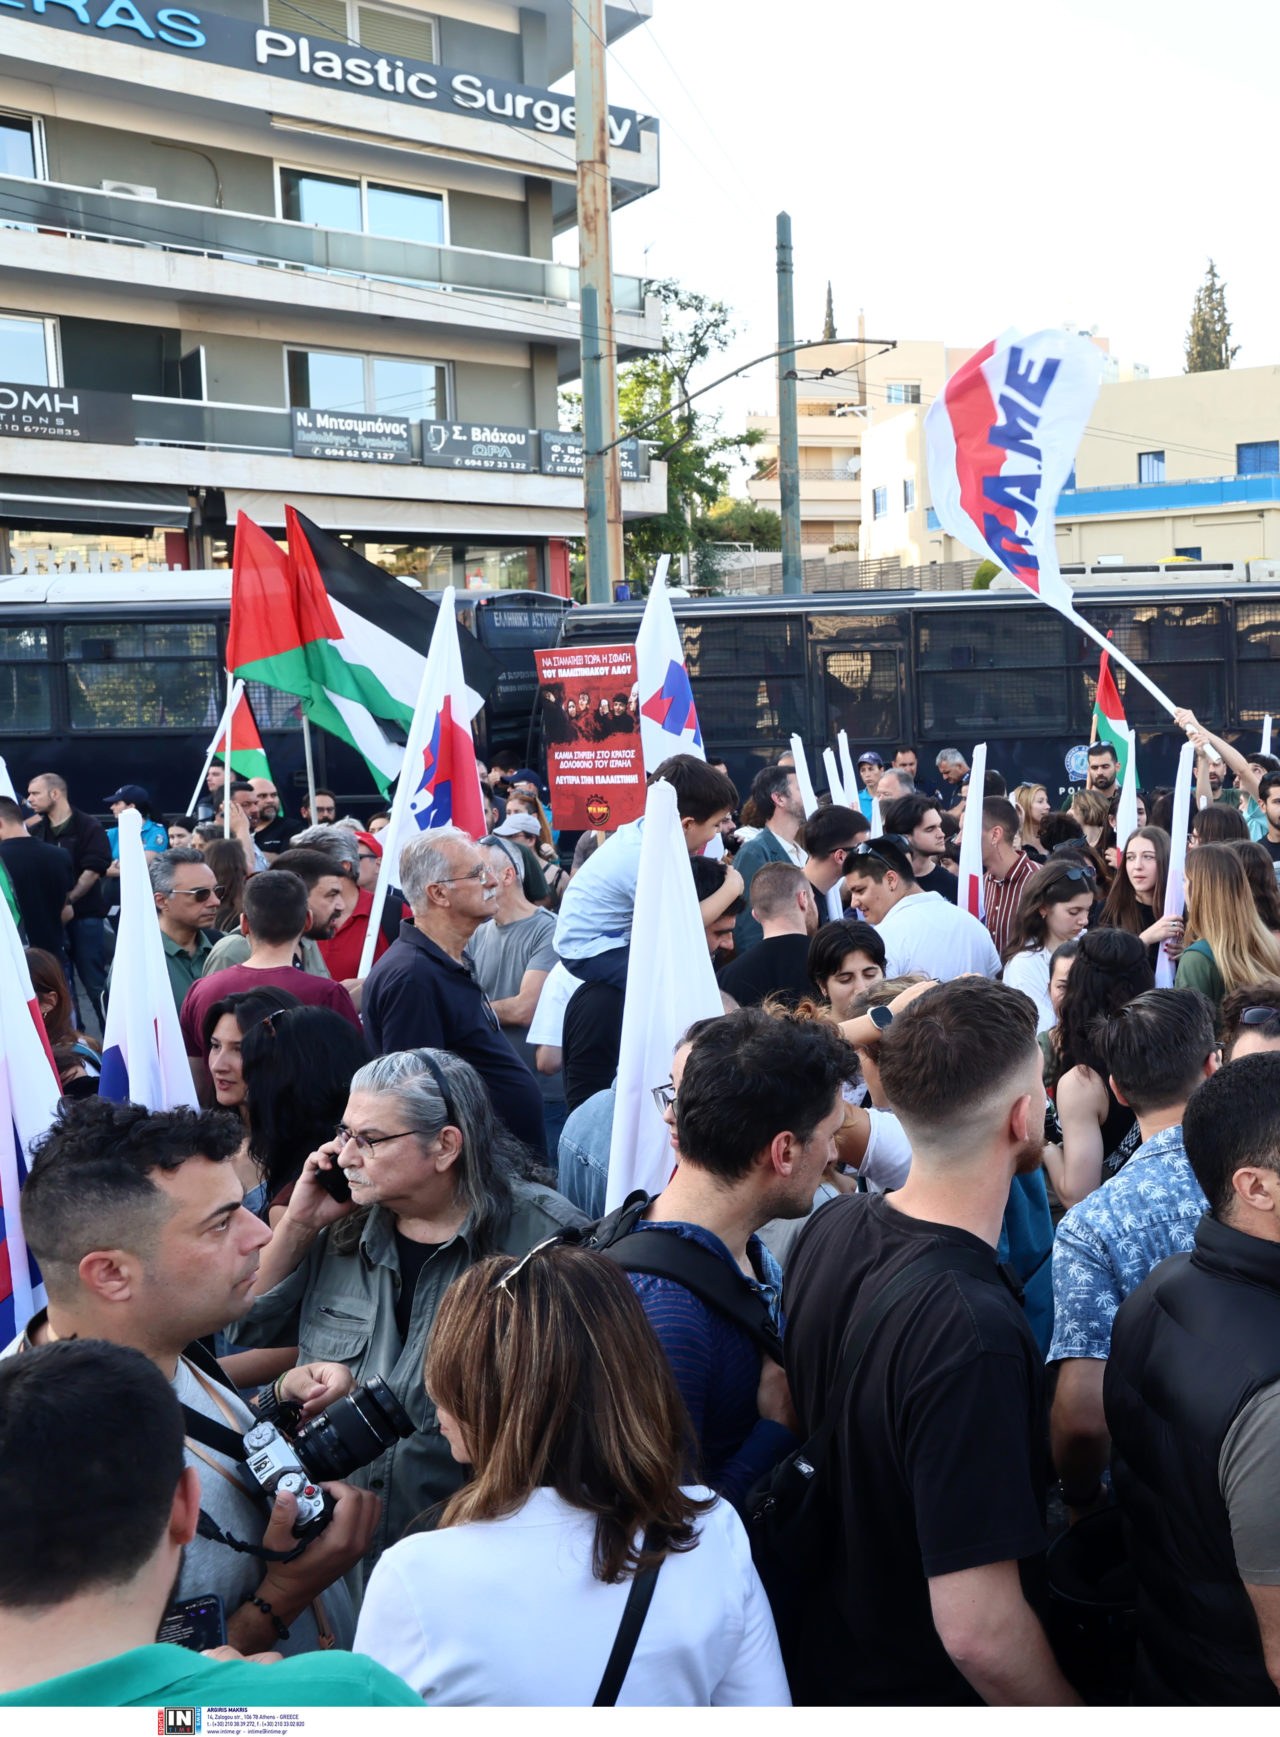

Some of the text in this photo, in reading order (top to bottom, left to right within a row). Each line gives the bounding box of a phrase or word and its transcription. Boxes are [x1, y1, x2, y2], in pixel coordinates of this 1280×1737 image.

[255, 29, 632, 147] Plastic Surgey
[296, 412, 313, 428] Ν.
[24, 425, 80, 437] 6770835
[452, 425, 468, 441] Σ.
[471, 427, 526, 446] Βλάχου
[324, 448, 395, 460] 694 62 92 127
[542, 652, 632, 667] ΝΑ ΣΤΑΜΑΤΗΣΕΙ ΤΩΡΑ Η ΣΦΑΓΗ
[542, 668, 556, 679] ΤΟΥ
[611, 665, 632, 675] ΛΑΟΥ
[554, 751, 573, 760] ΚΑΜΙΑ
[596, 750, 610, 759] ΣΤΟ
[611, 750, 636, 759] ΚΡΑΤΟΣ
[559, 759, 632, 769] ΔΟΛΟΦΟΝΟ ΤΟΥ ΙΣΡΑΗΛ
[555, 774, 639, 785] ΛΕΥΤΕΡΙΑ ΣΤΗΝ ΠΑΛΑΙΣΤΙΝΗ!
